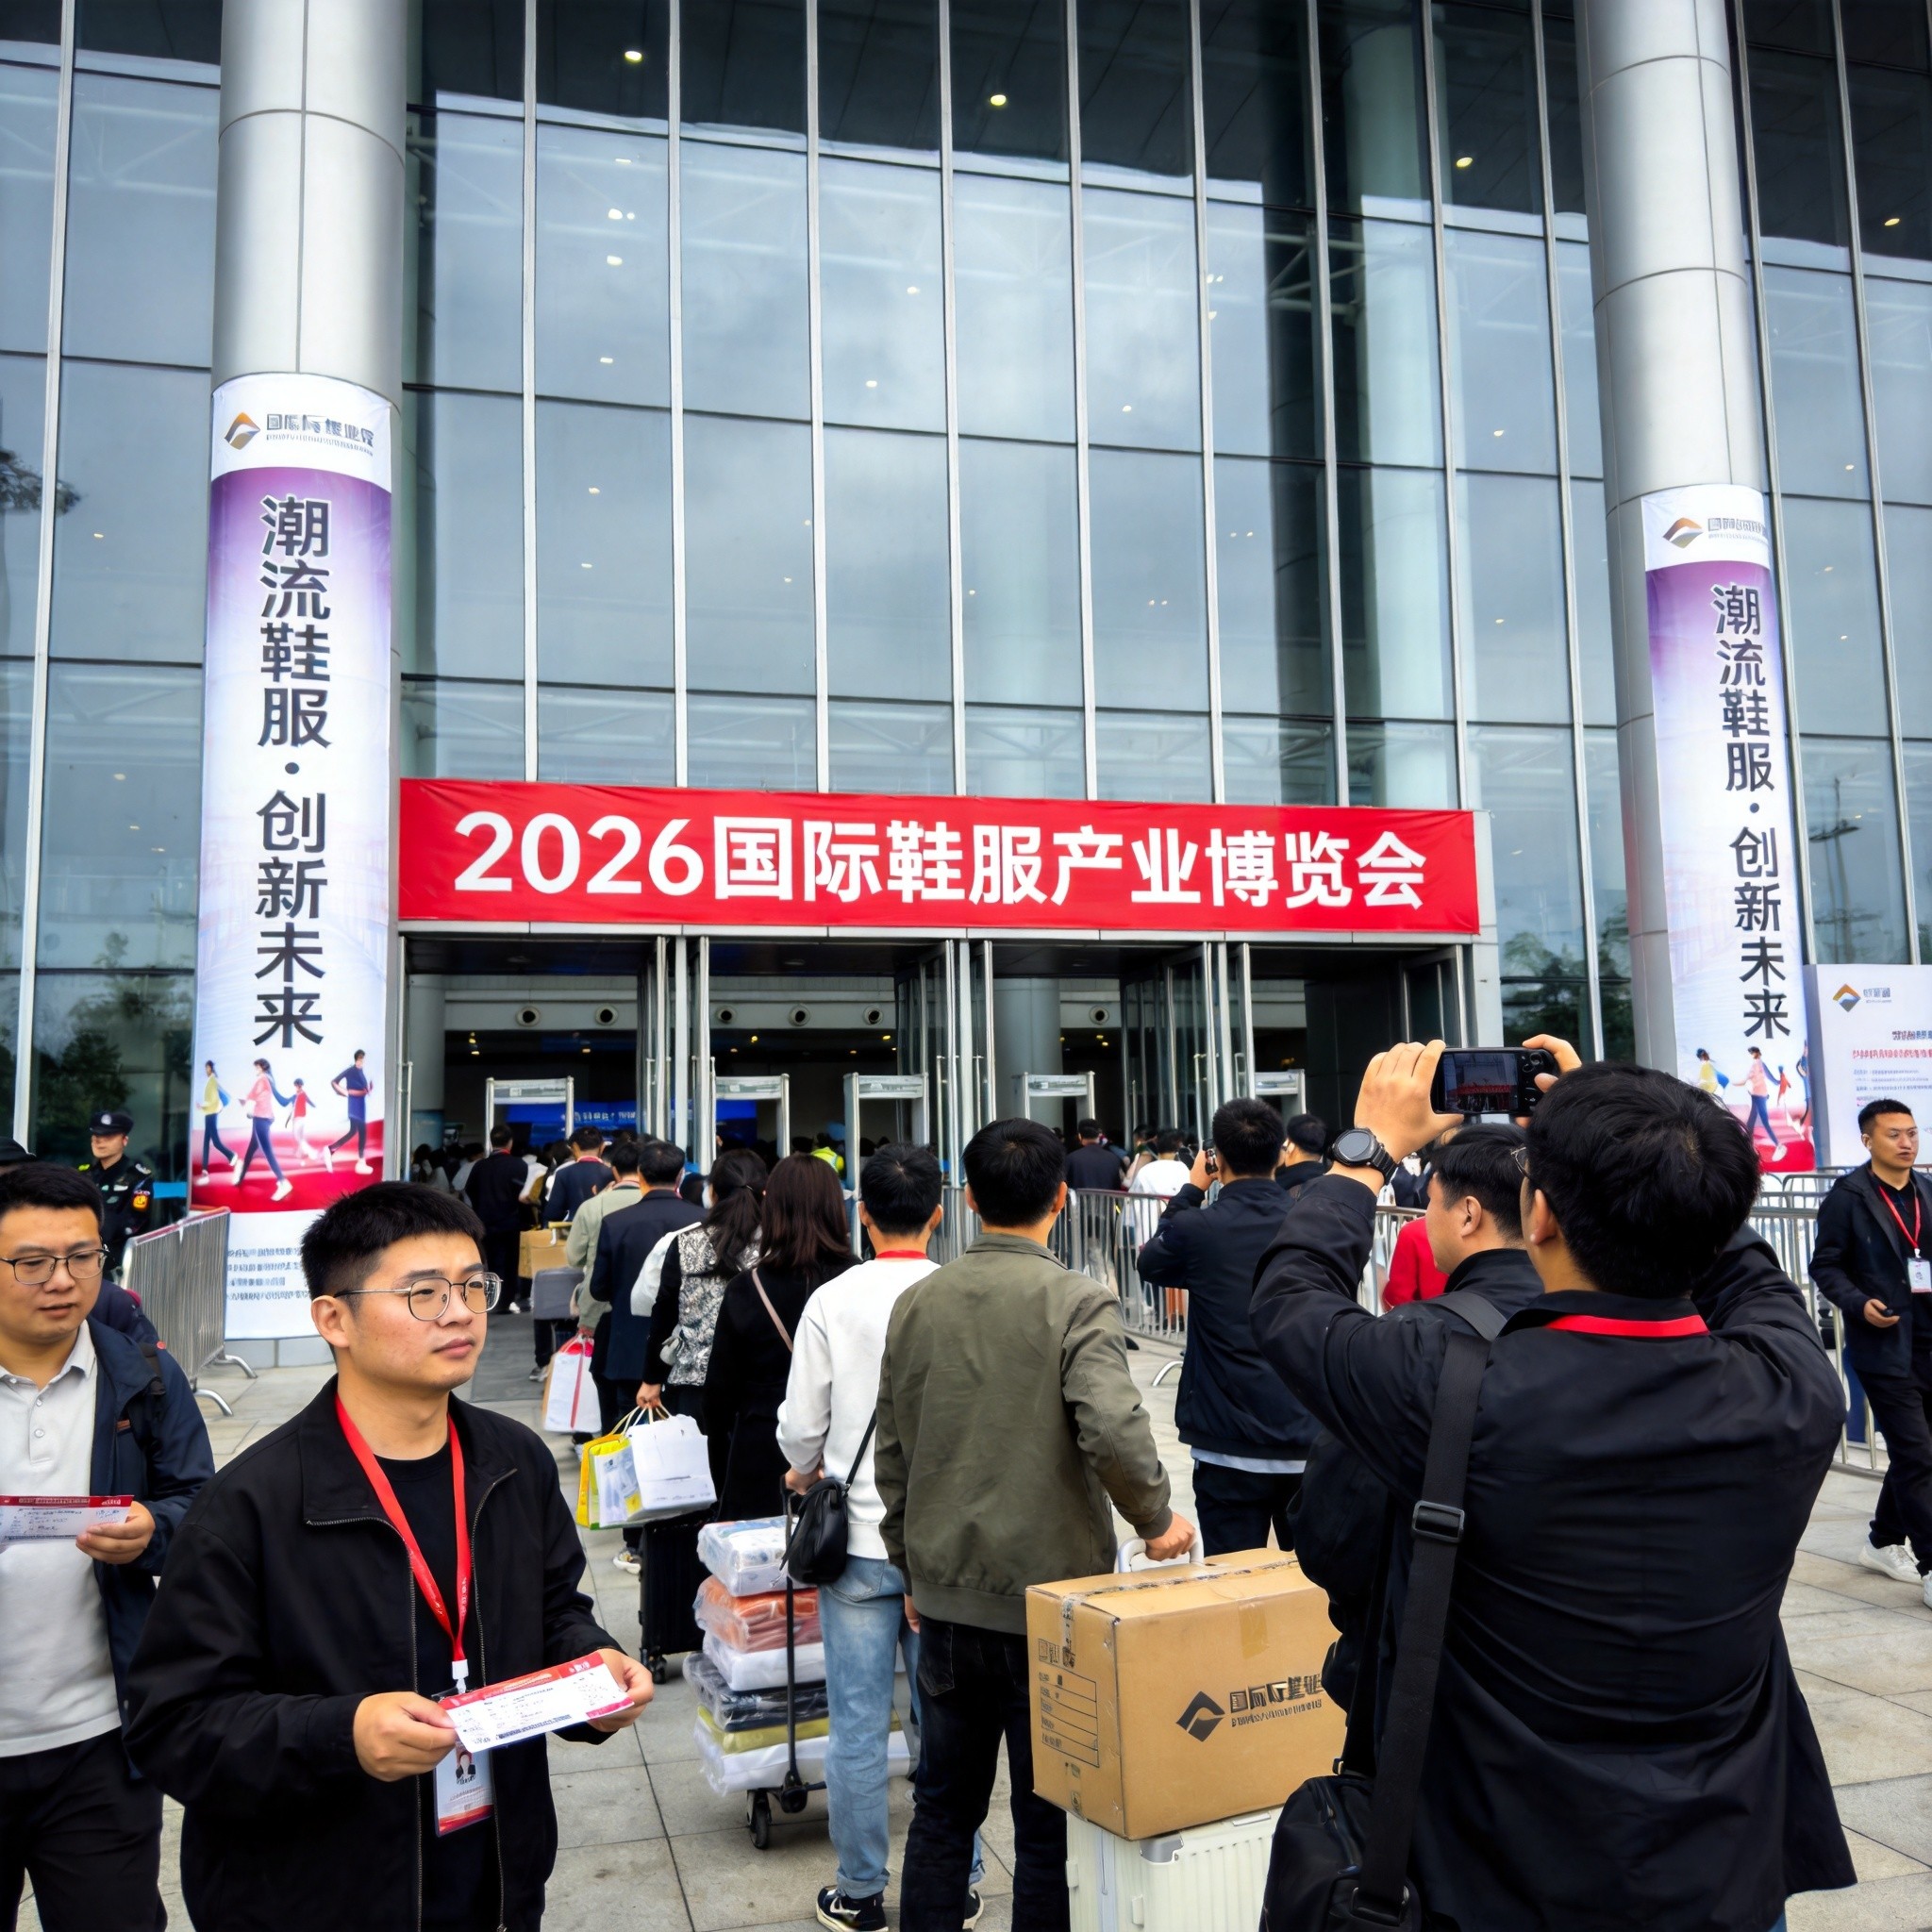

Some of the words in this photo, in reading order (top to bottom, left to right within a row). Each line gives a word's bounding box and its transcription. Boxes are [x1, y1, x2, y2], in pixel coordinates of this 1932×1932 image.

[253, 495, 332, 1048] 潮流鞋服·创新未来
[454, 810, 1426, 910] 2026国际鞋服产业博览会
[1712, 584, 1790, 1039] 潮流鞋服·创新未来
